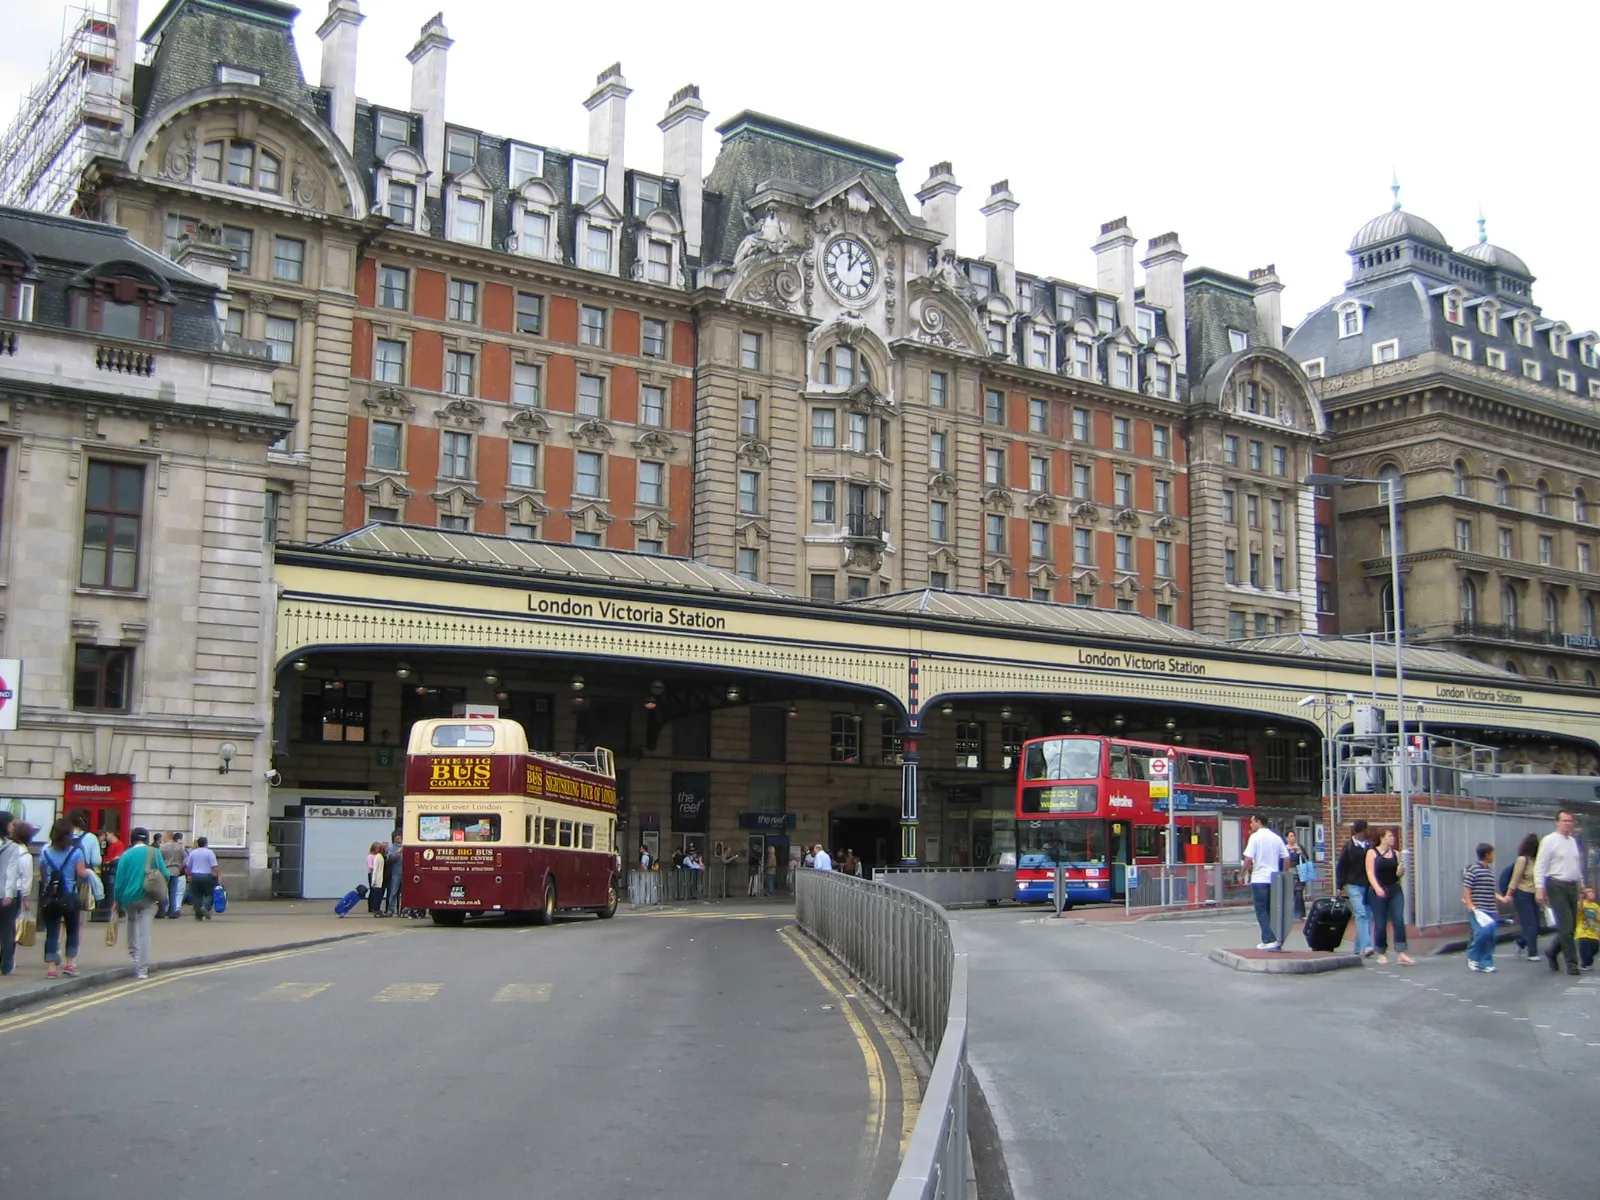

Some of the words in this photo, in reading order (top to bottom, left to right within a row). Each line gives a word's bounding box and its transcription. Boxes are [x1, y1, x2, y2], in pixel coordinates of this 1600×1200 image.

[528, 594, 592, 616] London
[598, 601, 663, 623] Victoria
[669, 608, 725, 629] Station
[1079, 649, 1120, 666] London
[1123, 654, 1165, 671] Victoria
[1168, 658, 1206, 674] Station
[1436, 684, 1464, 698] London
[1466, 688, 1495, 701] Victoria
[1497, 690, 1522, 704] Station
[1167, 748, 1175, 756] A
[430, 765, 490, 780] BUS
[527, 770, 542, 786] BUS
[74, 784, 112, 792] threshers
[580, 782, 594, 800] TOUR
[678, 792, 694, 802] the
[322, 808, 355, 816] CLASS
[358, 809, 393, 817] FRUITS
[680, 799, 704, 813] reef
[758, 815, 770, 824] the
[770, 814, 786, 823] reef
